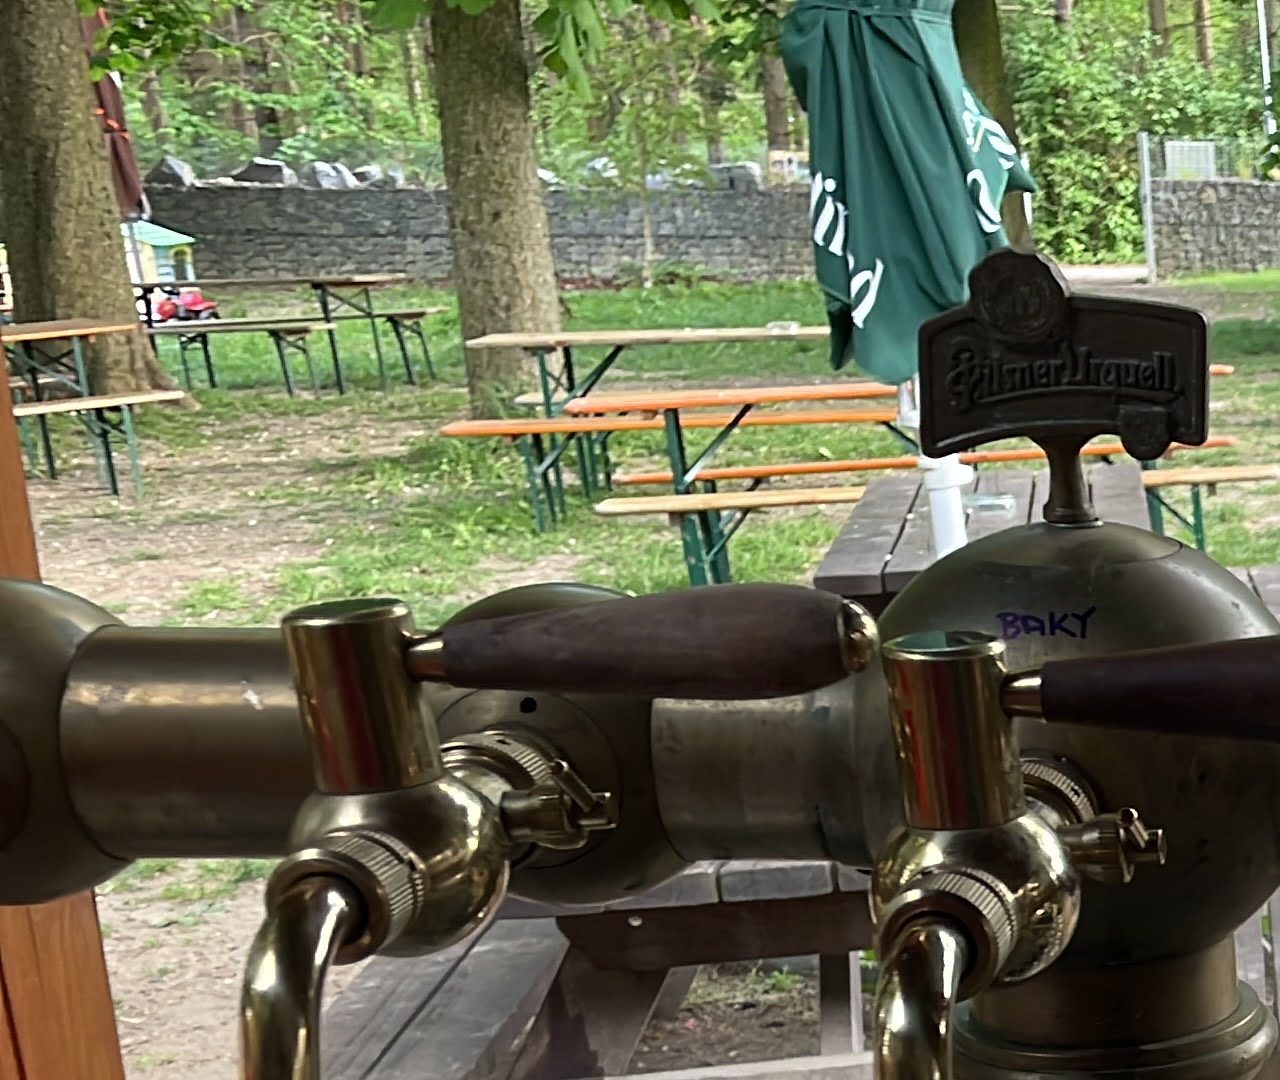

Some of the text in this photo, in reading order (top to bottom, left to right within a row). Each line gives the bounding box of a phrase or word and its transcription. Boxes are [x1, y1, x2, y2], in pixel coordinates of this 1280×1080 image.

[945, 336, 1180, 411] Pilsner Urquell
[996, 606, 1097, 640] BAKY
